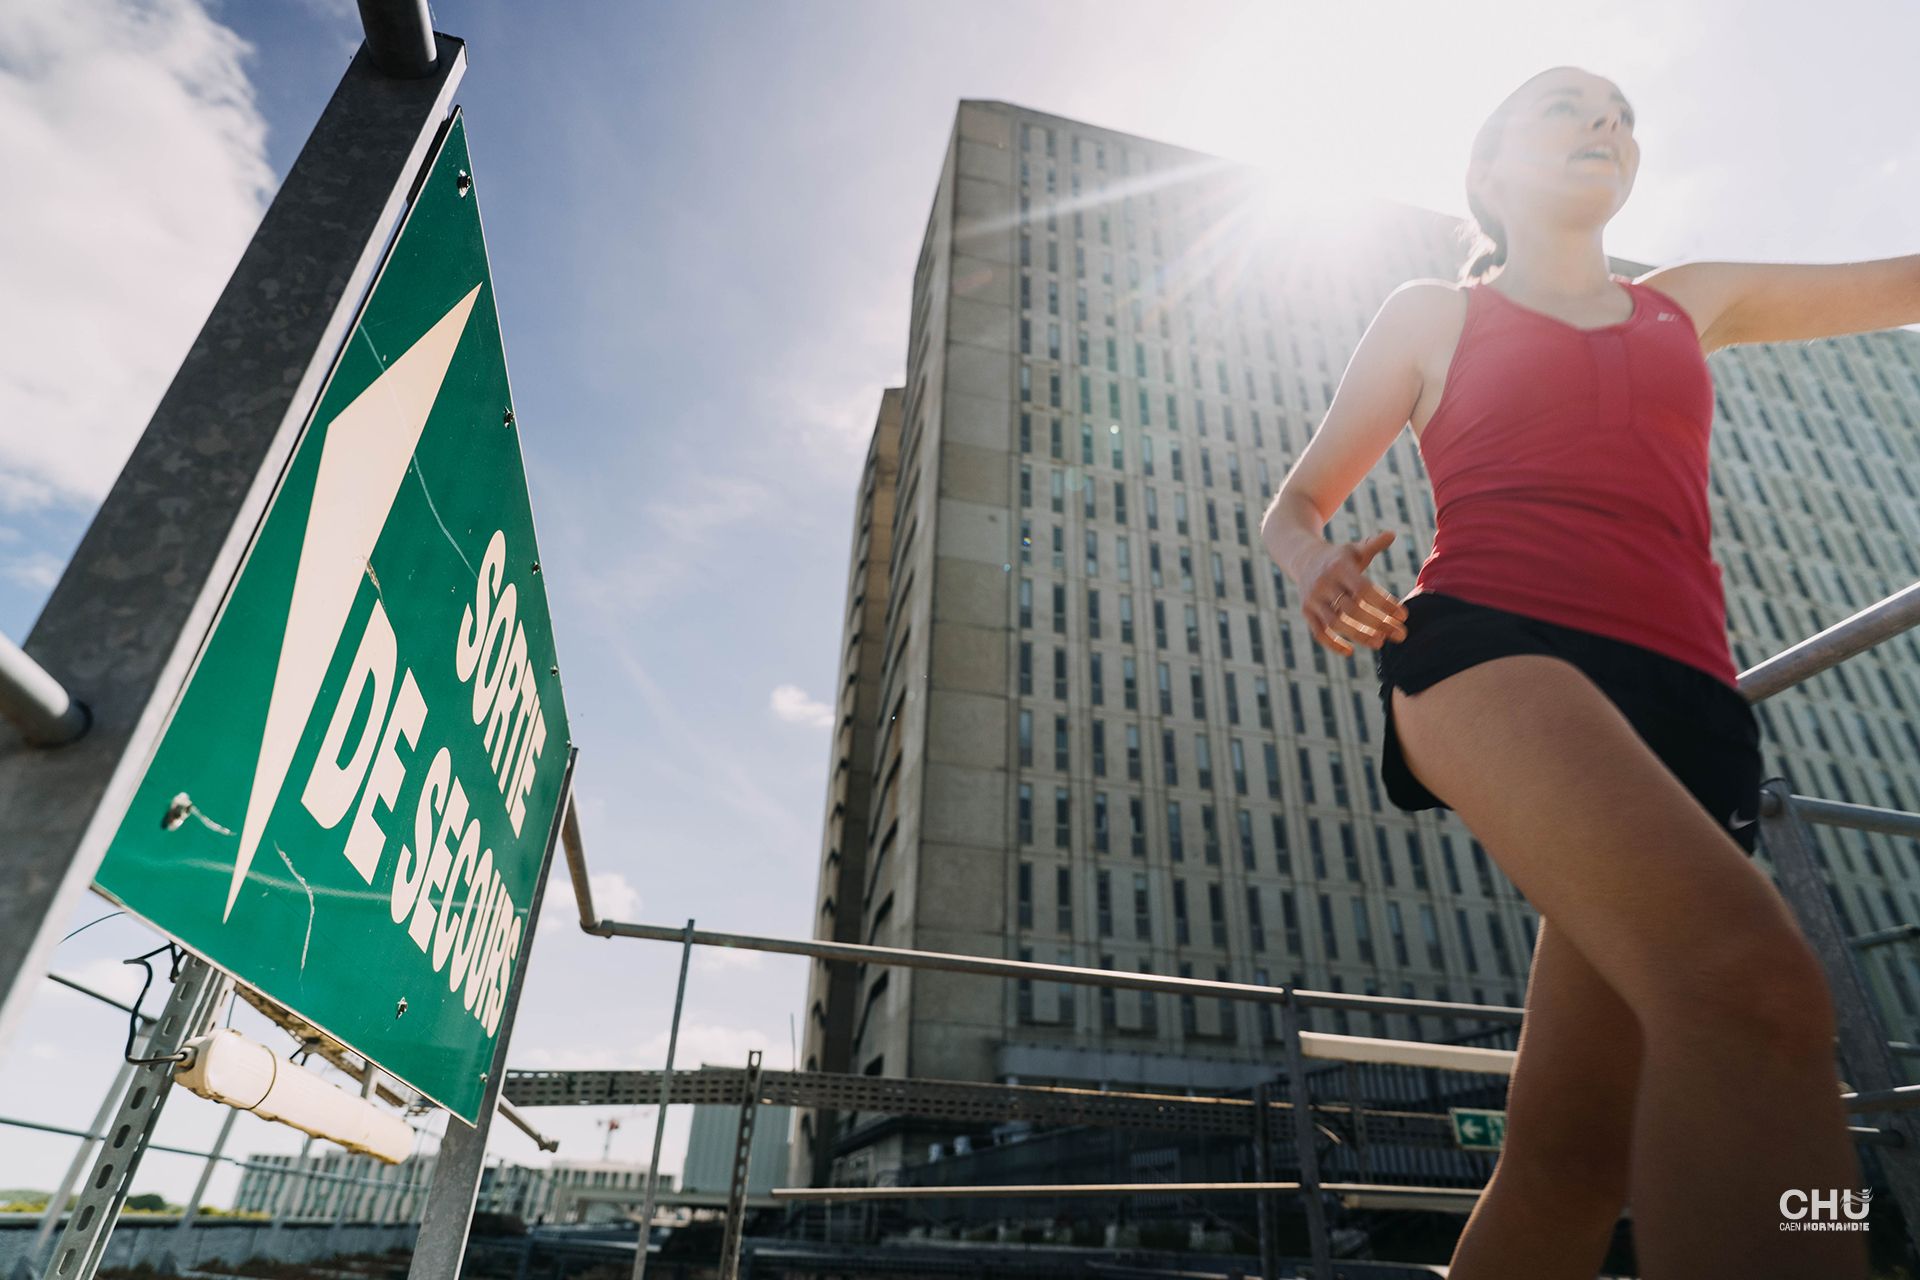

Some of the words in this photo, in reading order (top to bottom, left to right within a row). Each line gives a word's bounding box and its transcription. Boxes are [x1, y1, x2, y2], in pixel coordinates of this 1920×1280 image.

[301, 599, 428, 885] DE
[390, 747, 521, 1038] SECOURS
[456, 530, 546, 838] SORTIE
